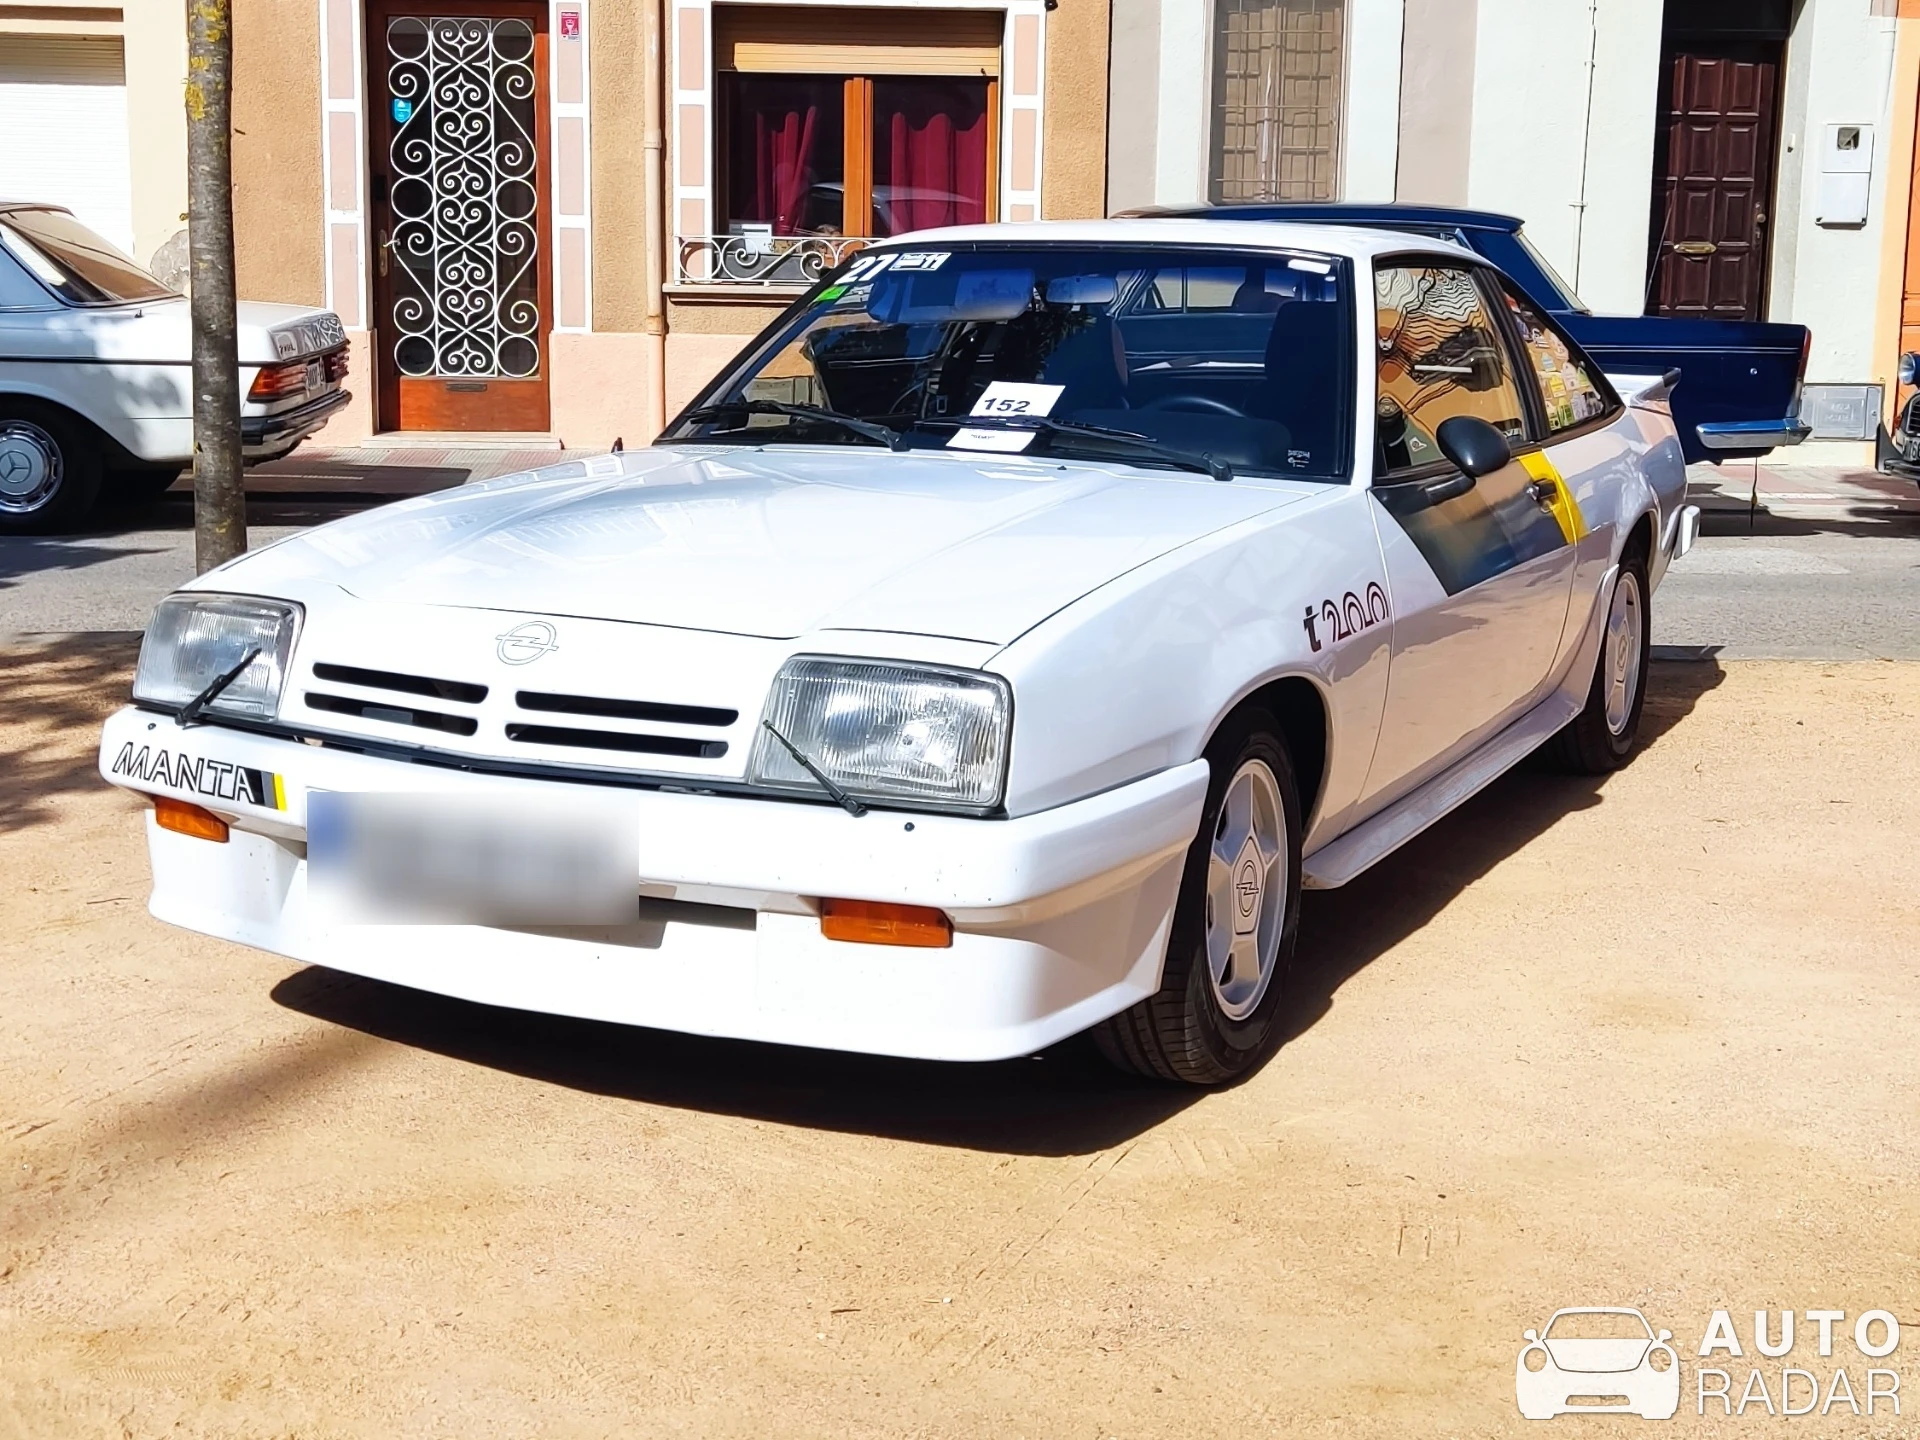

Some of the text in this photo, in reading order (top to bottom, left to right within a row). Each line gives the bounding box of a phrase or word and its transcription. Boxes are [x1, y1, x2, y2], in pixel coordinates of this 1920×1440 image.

[834, 253, 899, 285] 27
[984, 397, 1031, 413] 152
[112, 741, 254, 803] MANTA
